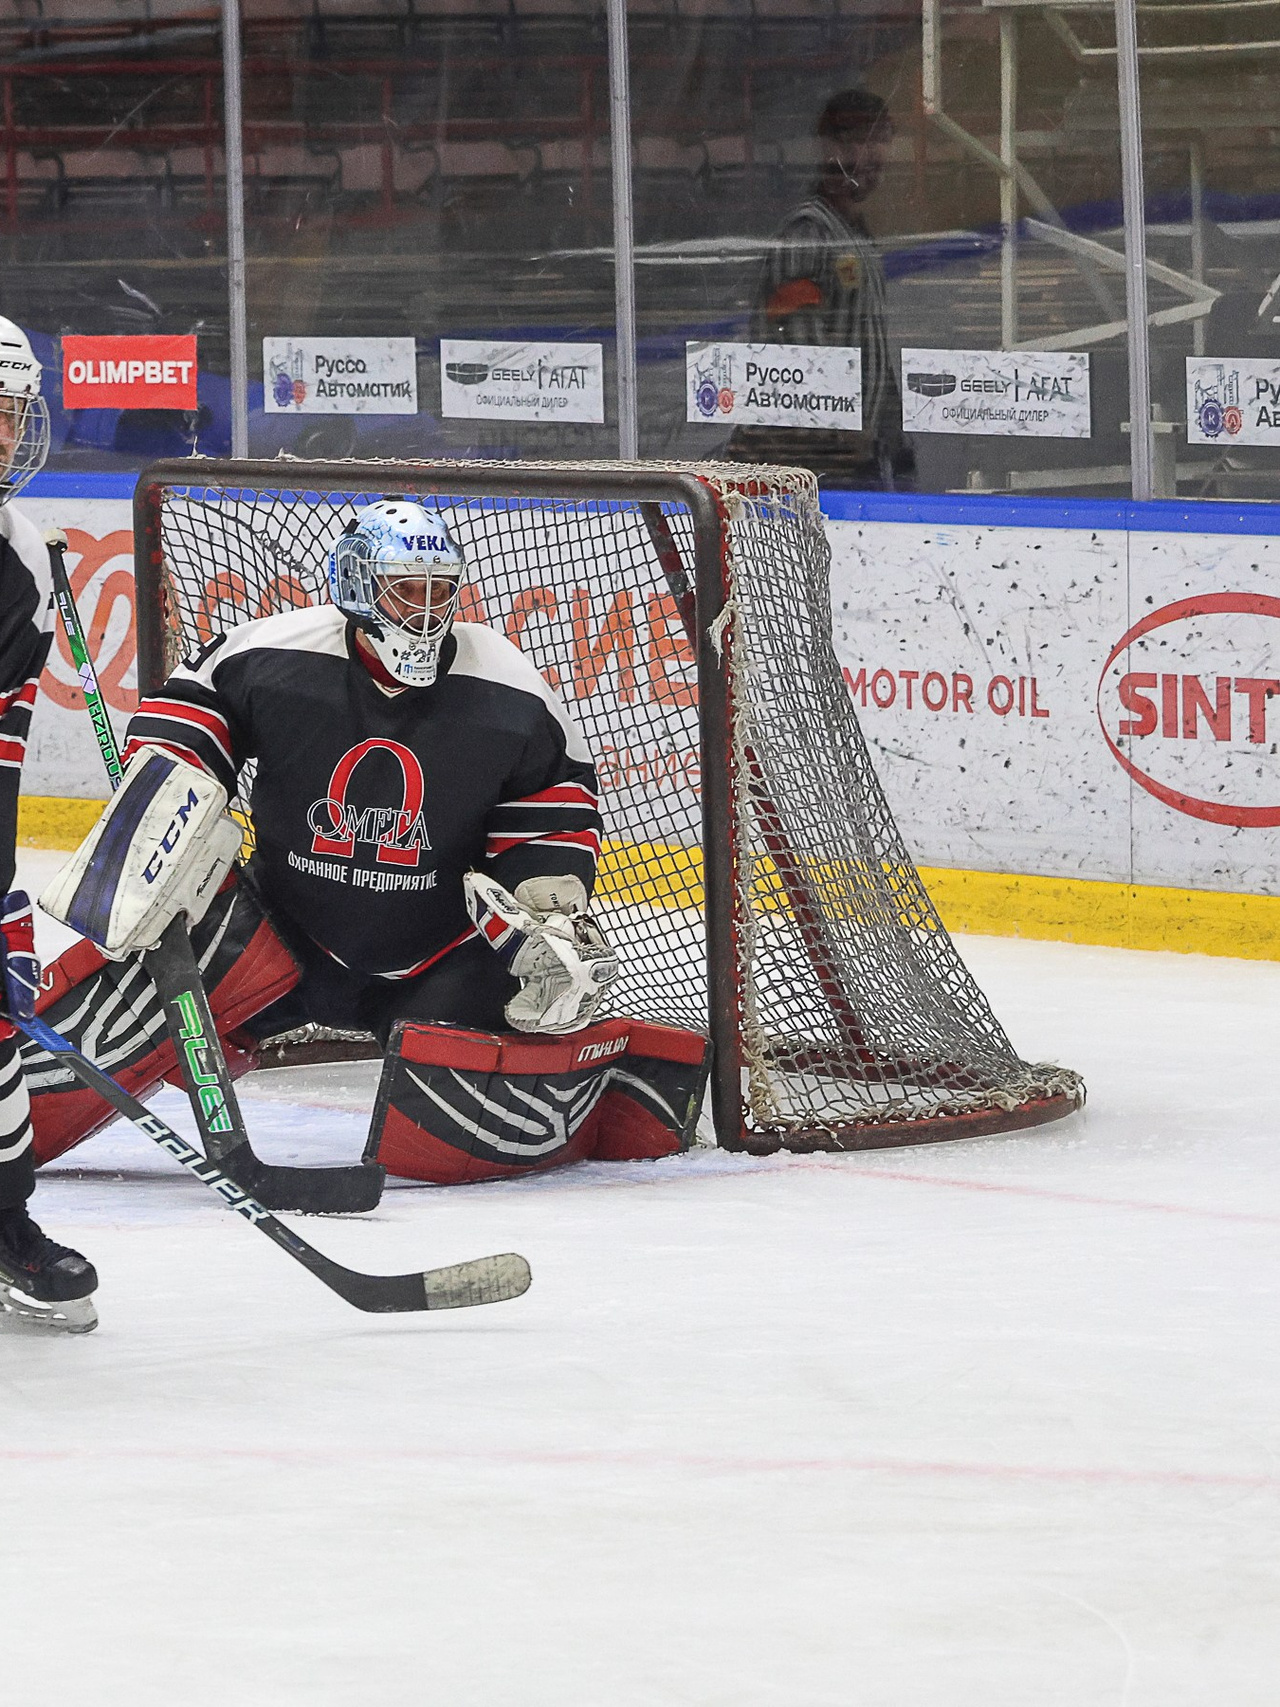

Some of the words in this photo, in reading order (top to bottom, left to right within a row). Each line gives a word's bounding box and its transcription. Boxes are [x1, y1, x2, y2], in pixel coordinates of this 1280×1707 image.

[68, 359, 193, 385] OLIMPBET
[315, 355, 367, 378] Руссо
[492, 369, 535, 381] GEELY
[746, 362, 804, 386] Руссо
[316, 379, 412, 399] Автоматик
[960, 379, 1011, 393] GEELY
[745, 388, 855, 412] Автоматик
[942, 407, 1016, 420] ОФИЦИАЛЬНЫЙ
[1019, 409, 1049, 422] ДИЛЕР
[402, 535, 450, 553] VEKA
[329, 552, 337, 585] VEKA
[844, 667, 974, 713] MOTOR
[988, 674, 1050, 718] OIL
[141, 787, 199, 884] CCM
[307, 797, 433, 850] ОМЕГА
[287, 850, 349, 884] ОХРАННОЕ
[352, 869, 438, 892] ПРЕДПРИЯТИЕ
